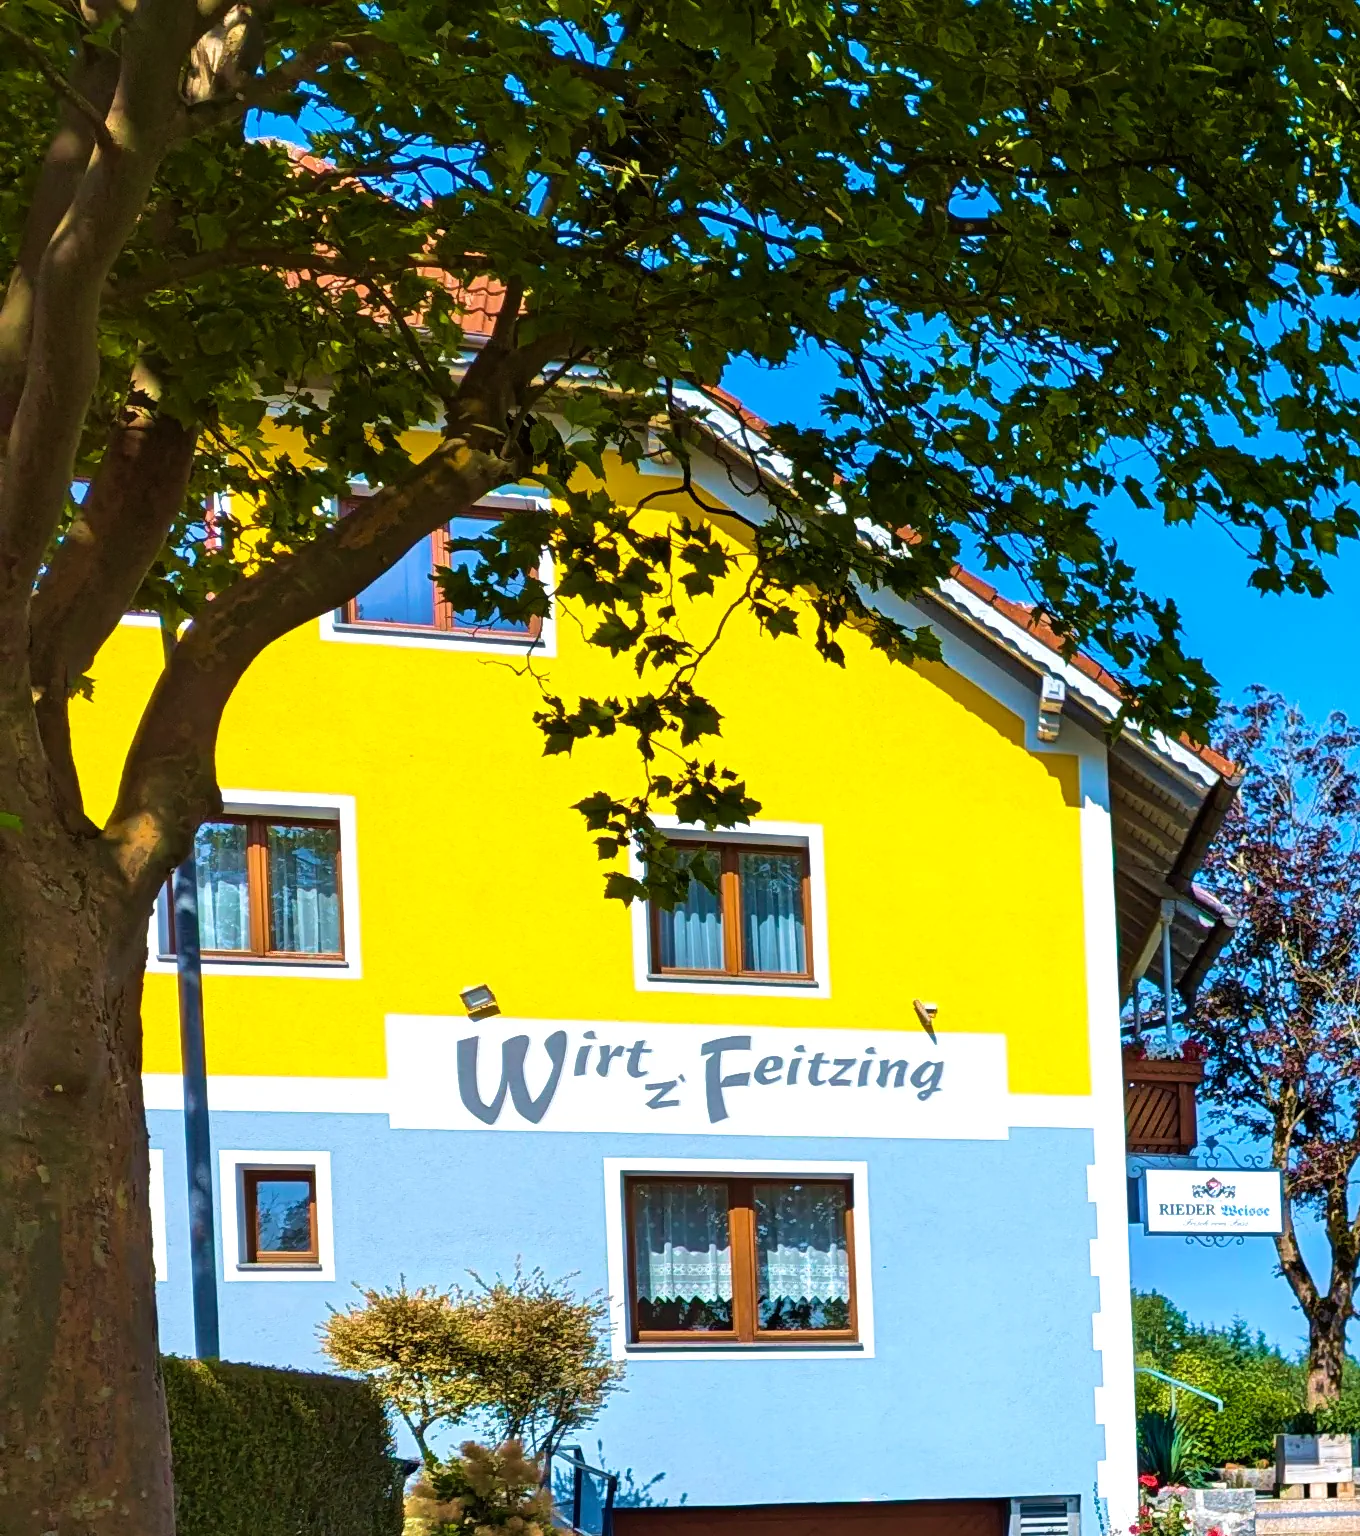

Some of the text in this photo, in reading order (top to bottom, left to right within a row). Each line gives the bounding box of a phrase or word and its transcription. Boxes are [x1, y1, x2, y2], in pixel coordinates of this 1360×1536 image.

[456, 1030, 649, 1125] Wirt
[700, 1035, 945, 1123] Feitzing
[1158, 1203, 1271, 1217] RIEDER Weisse
